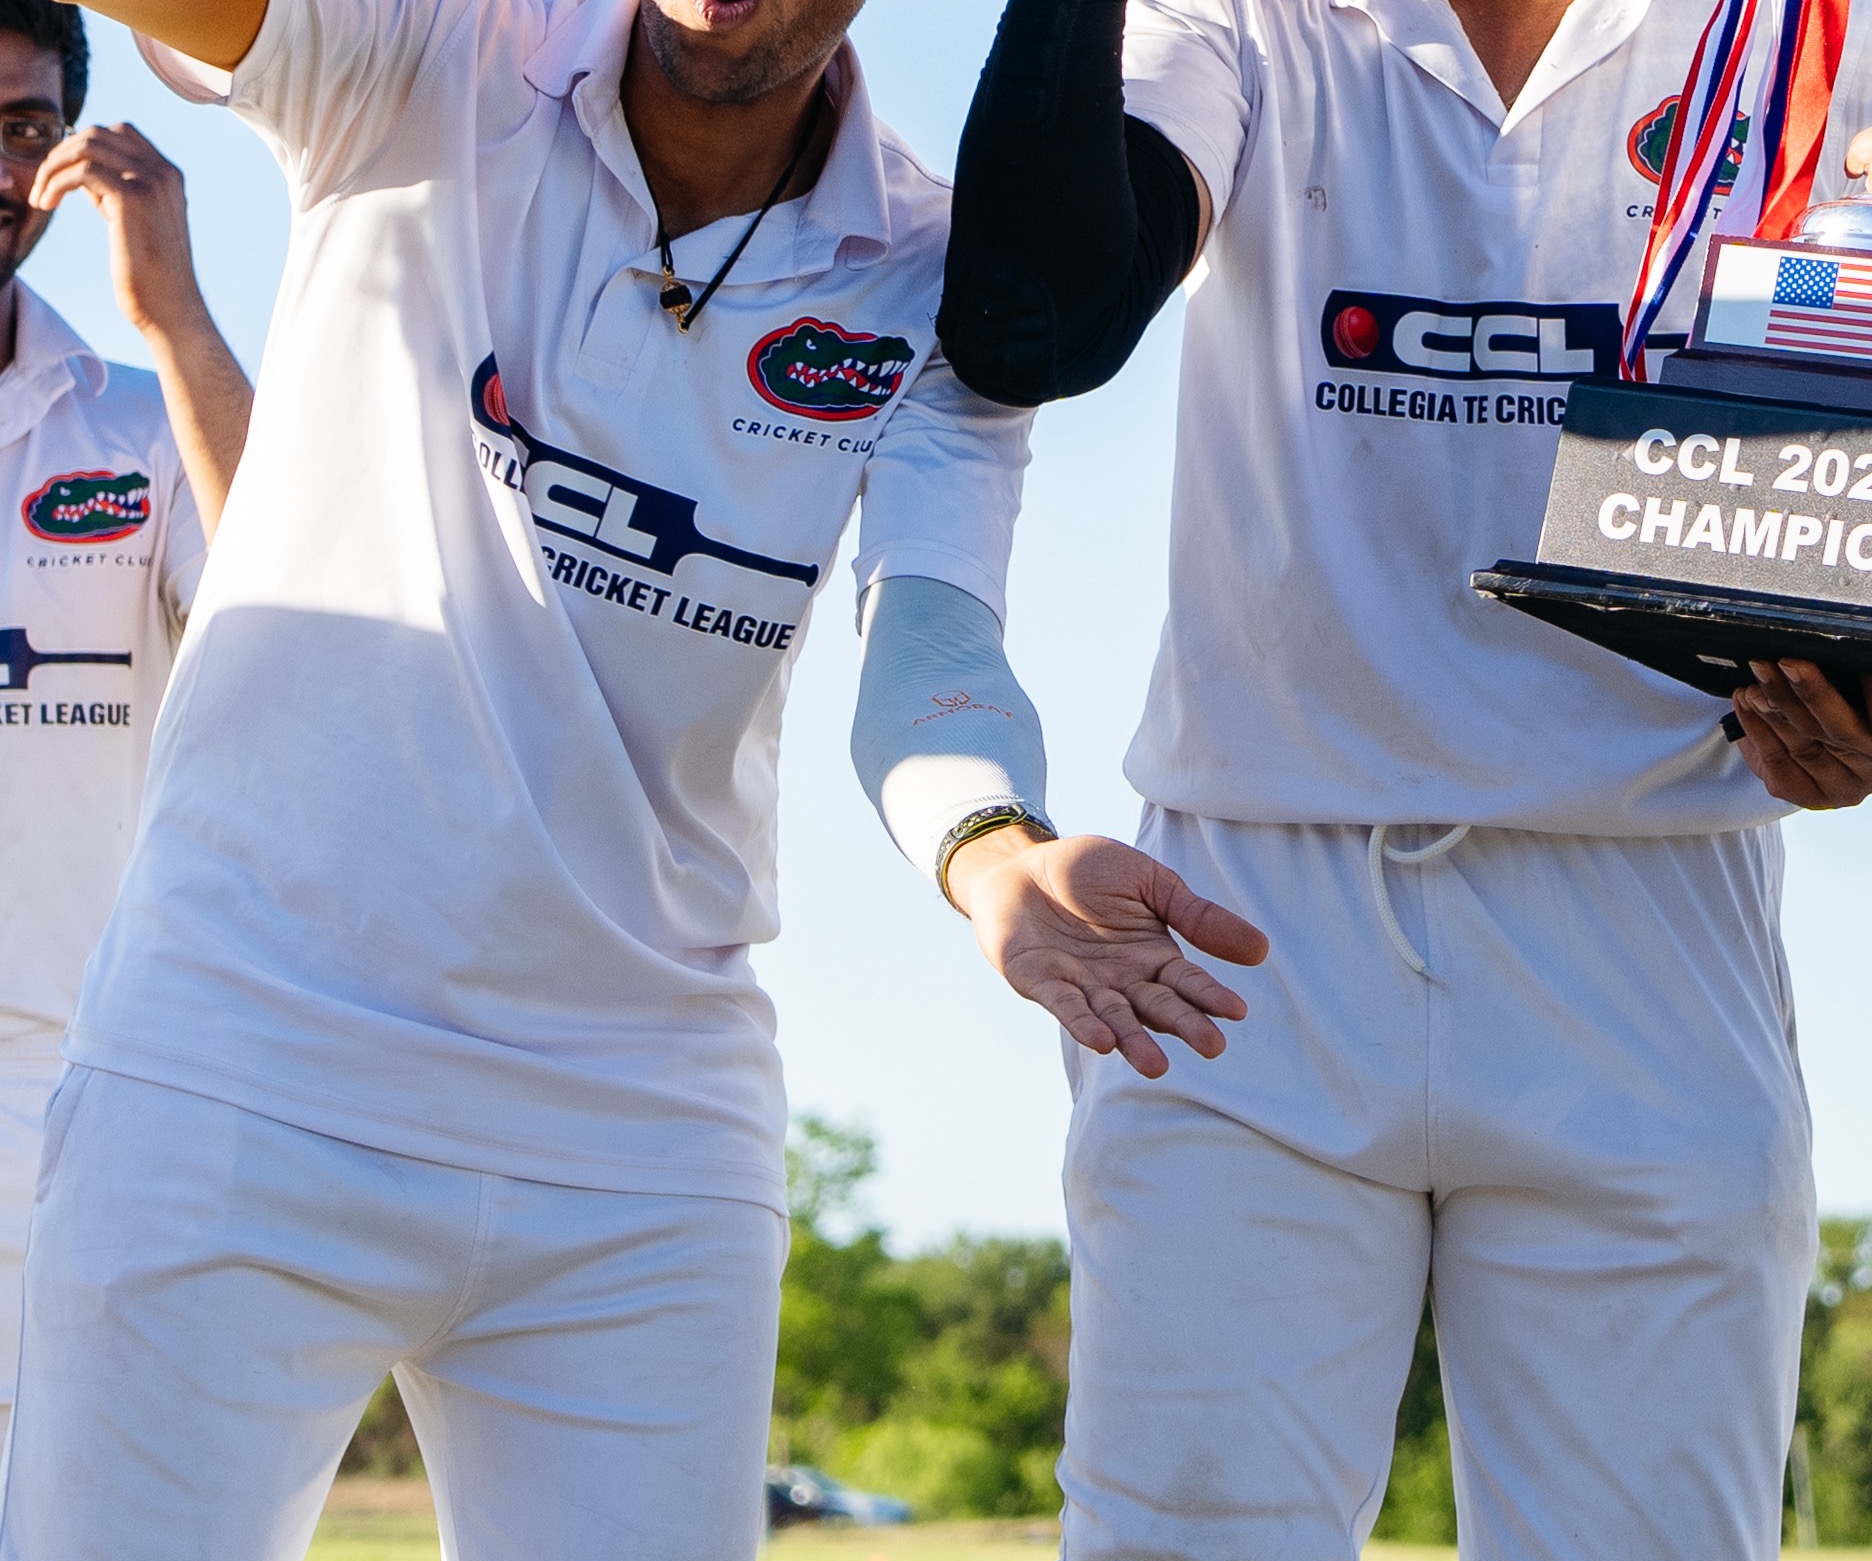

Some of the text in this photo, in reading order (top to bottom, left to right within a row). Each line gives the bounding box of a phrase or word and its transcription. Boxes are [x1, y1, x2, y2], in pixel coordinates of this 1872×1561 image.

[1393, 311, 1594, 373] CCL
[1495, 394, 1566, 425] CRIC
[732, 418, 873, 453] CRICKET CLU
[1634, 428, 1755, 487] CCL
[523, 460, 658, 560] CL
[115, 551, 152, 566] CLU
[673, 596, 796, 650] LEAGUE
[40, 702, 130, 726] LEAGUE
